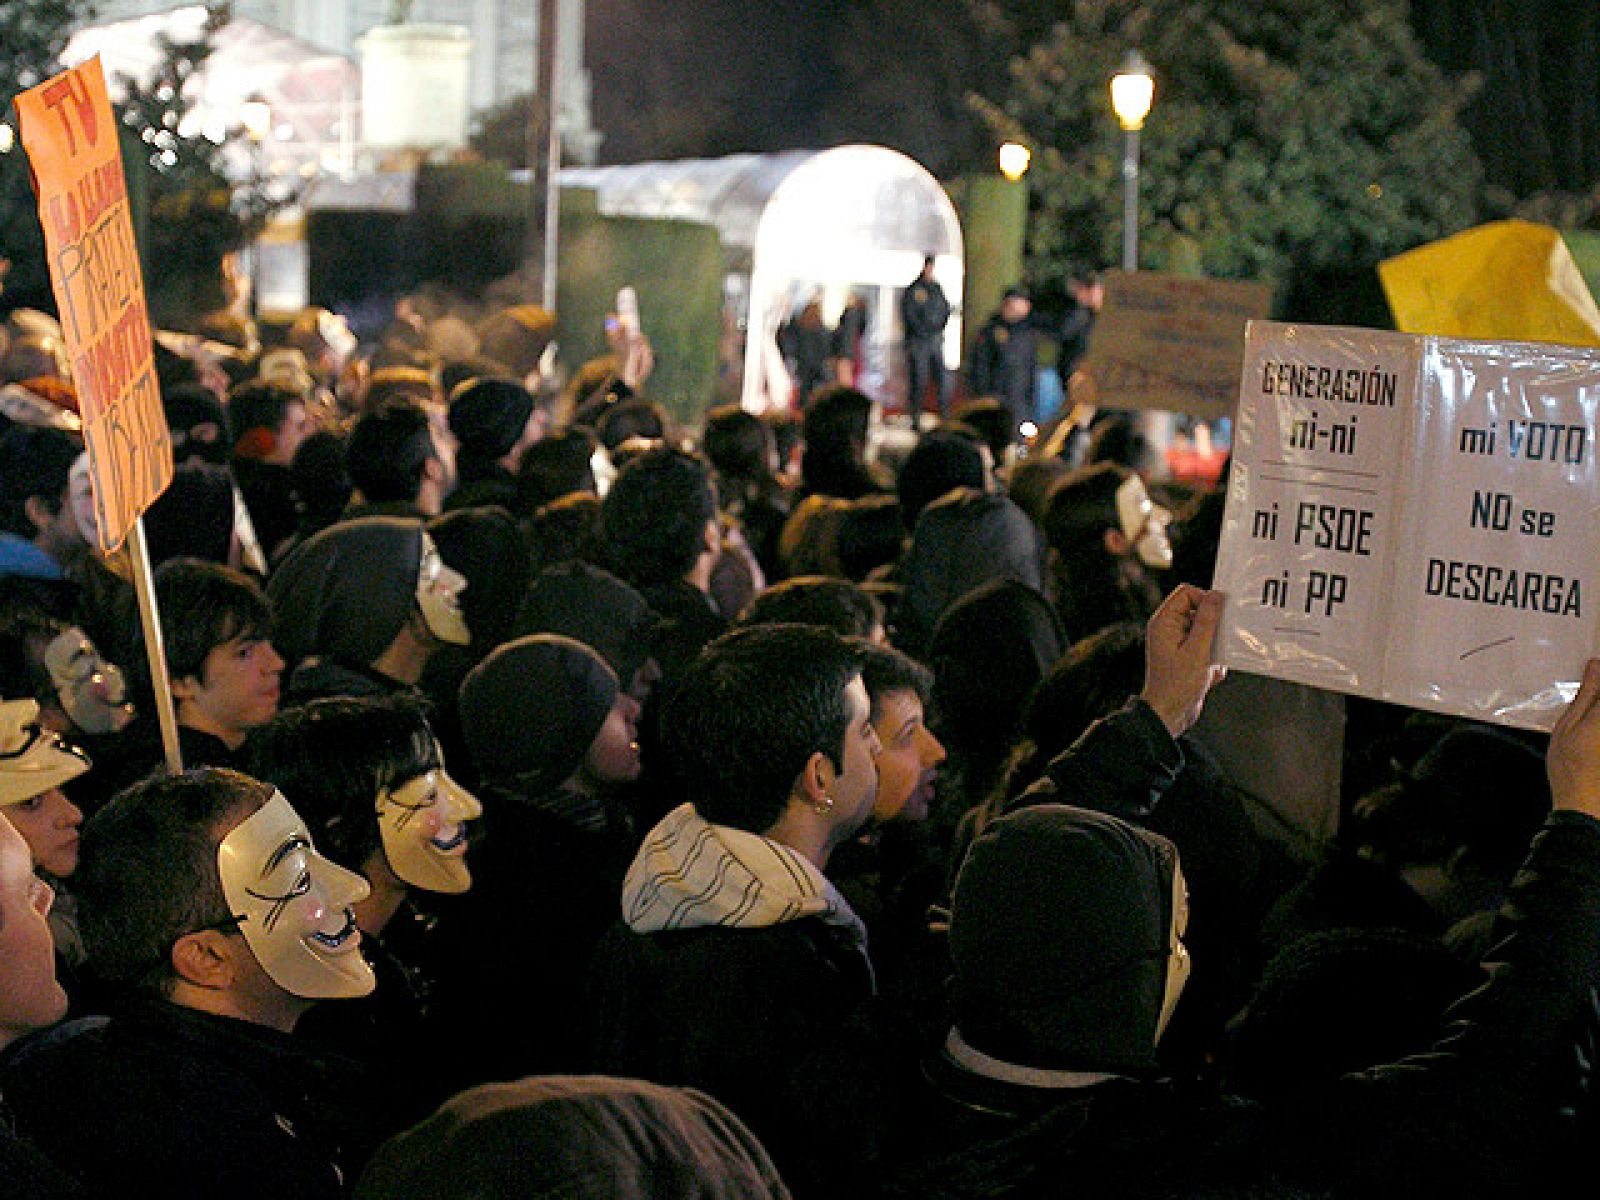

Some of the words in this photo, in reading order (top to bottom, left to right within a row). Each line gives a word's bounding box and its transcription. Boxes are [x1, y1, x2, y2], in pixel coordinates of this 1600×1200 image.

[1262, 362, 1396, 408] GENERACIÓN
[1289, 411, 1357, 455] ni-ni
[1459, 422, 1496, 456] mi
[1508, 419, 1586, 464] VOTO
[1252, 502, 1279, 541] ni
[1294, 502, 1374, 556] PSOE
[1470, 489, 1513, 531] NO
[1519, 508, 1556, 537] se
[1260, 569, 1289, 609] ni
[1304, 569, 1348, 617] PP
[1425, 558, 1581, 618] DESCARGA
